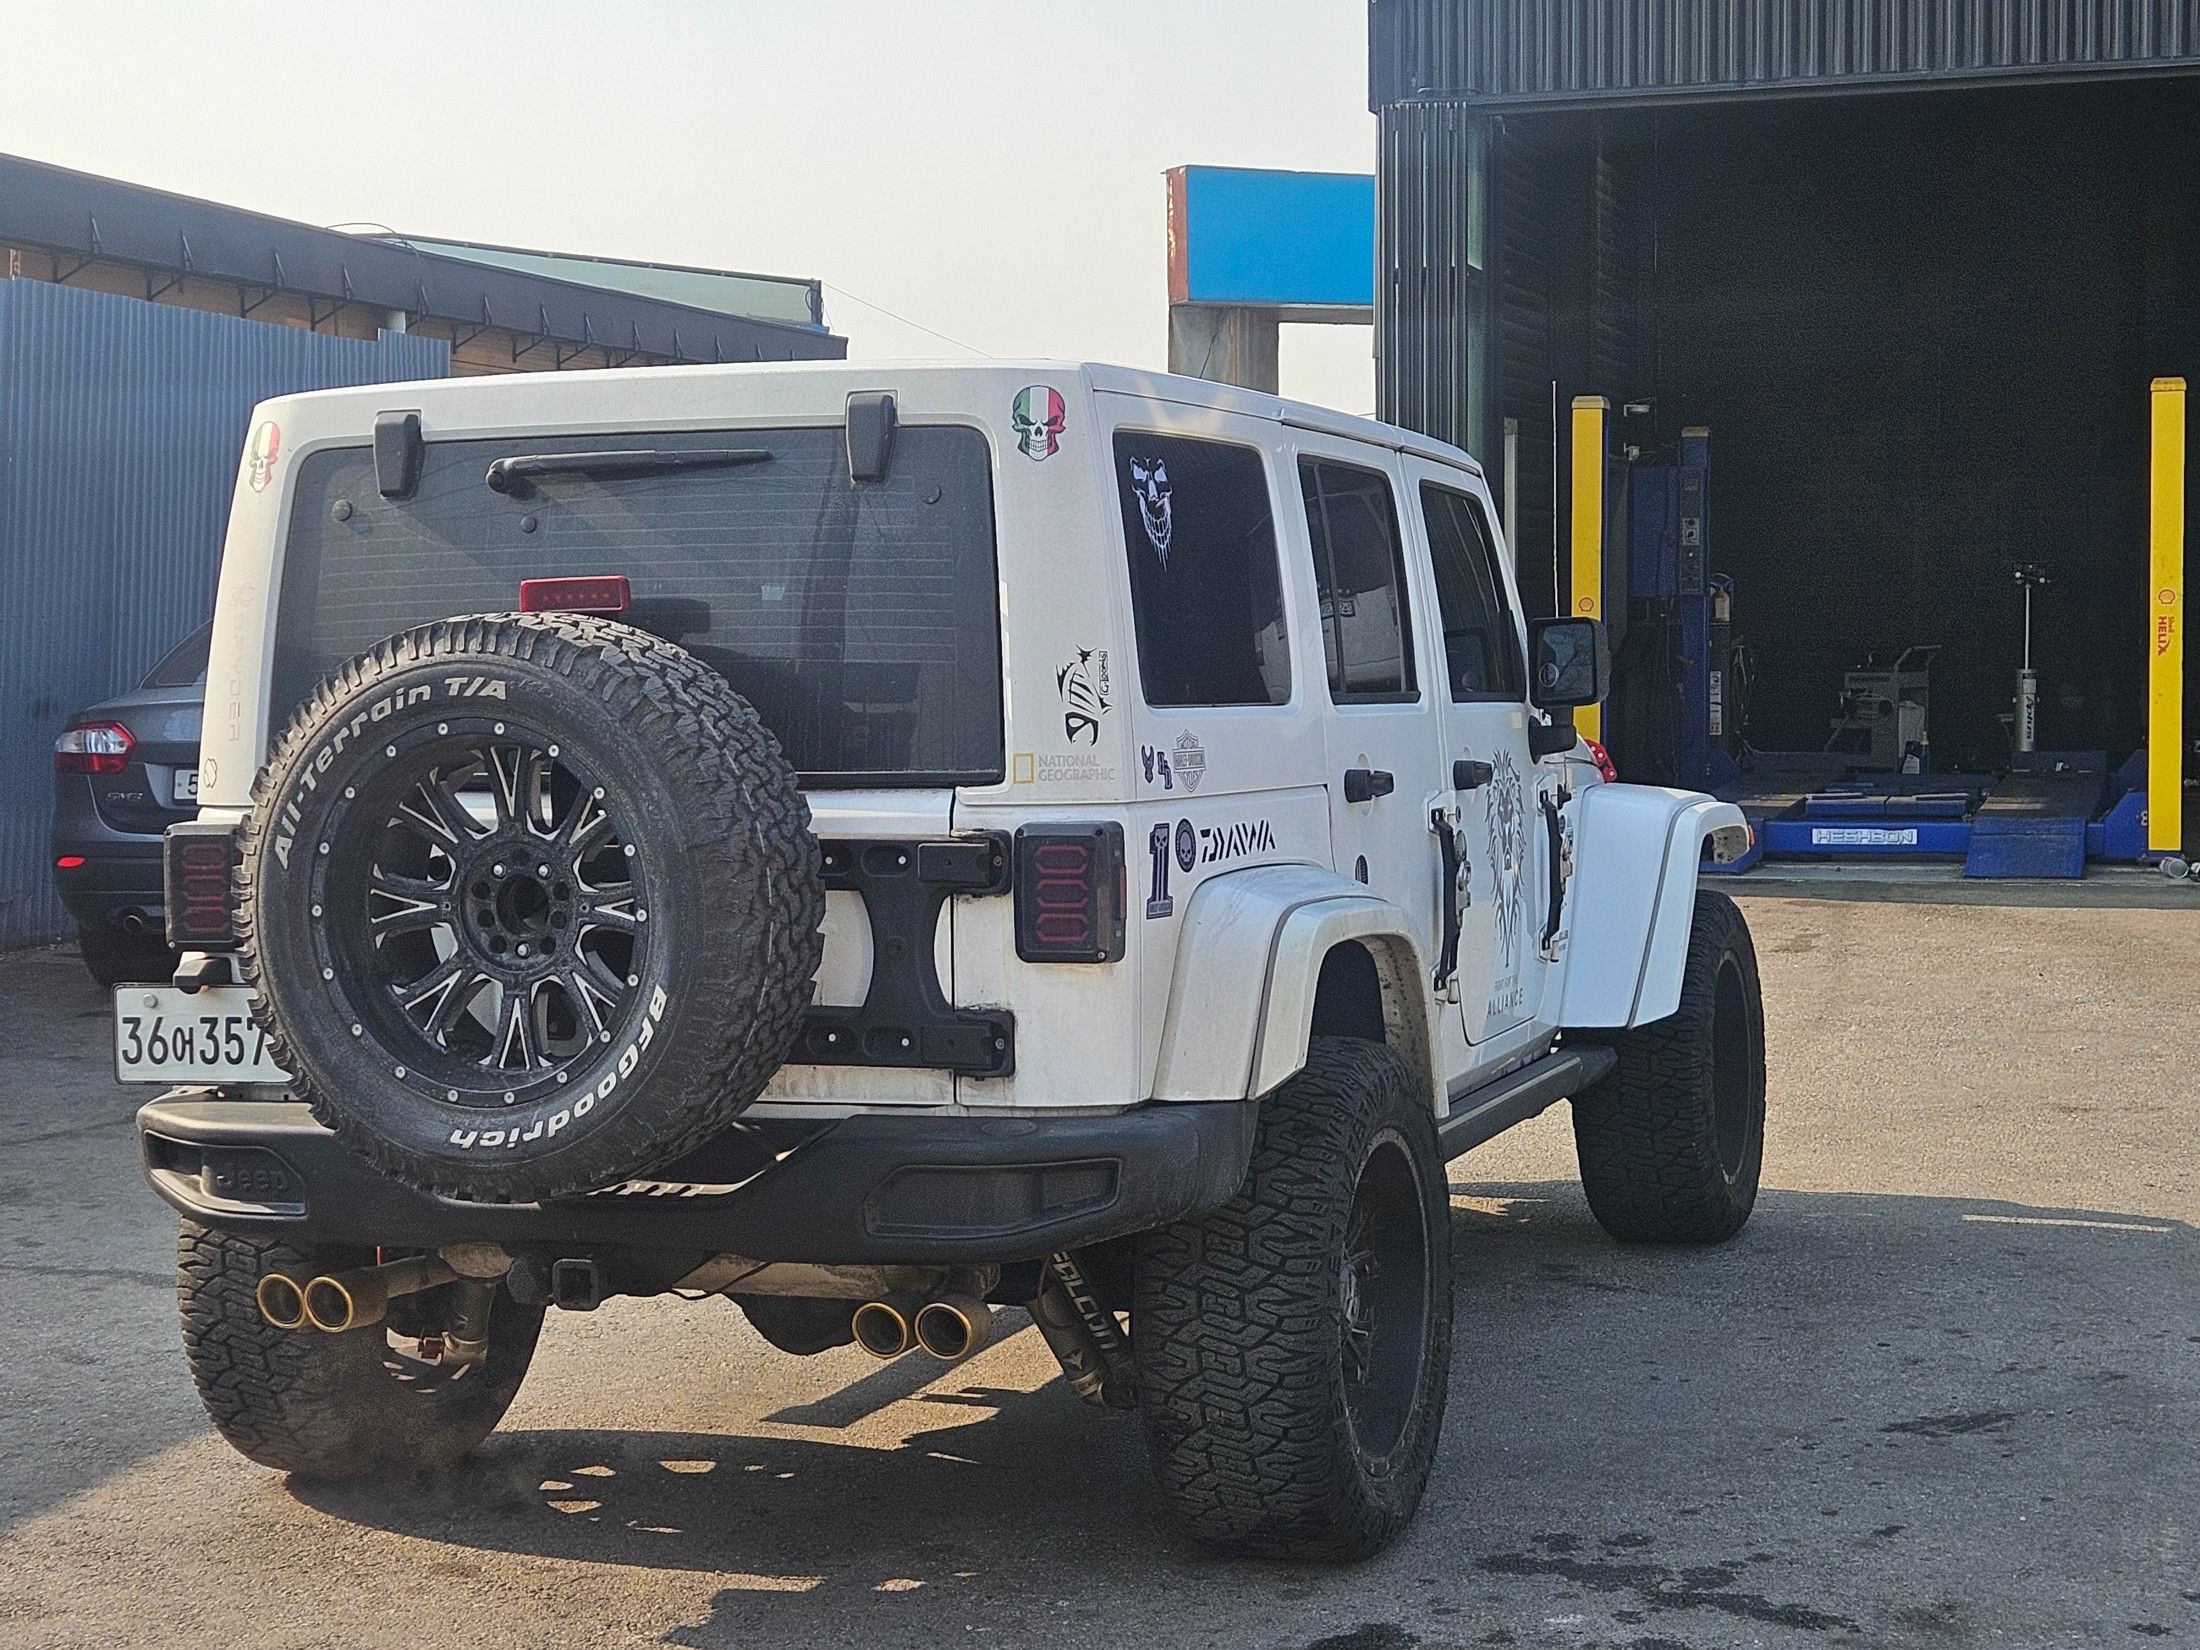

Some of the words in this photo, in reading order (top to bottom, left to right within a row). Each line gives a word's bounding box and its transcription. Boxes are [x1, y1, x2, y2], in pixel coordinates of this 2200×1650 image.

[2157, 616, 2171, 657] HELIX
[273, 683, 432, 871] All-Terrain
[444, 676, 507, 701] T/A
[1038, 754, 1100, 767] NATIONAL
[1038, 768, 1116, 782] GEOGRAPHIC
[1199, 818, 1277, 864] DAIWA
[1818, 830, 1915, 843] HESHBON
[121, 1016, 266, 1066] 36어357
[449, 984, 668, 1150] BFGoodrich
